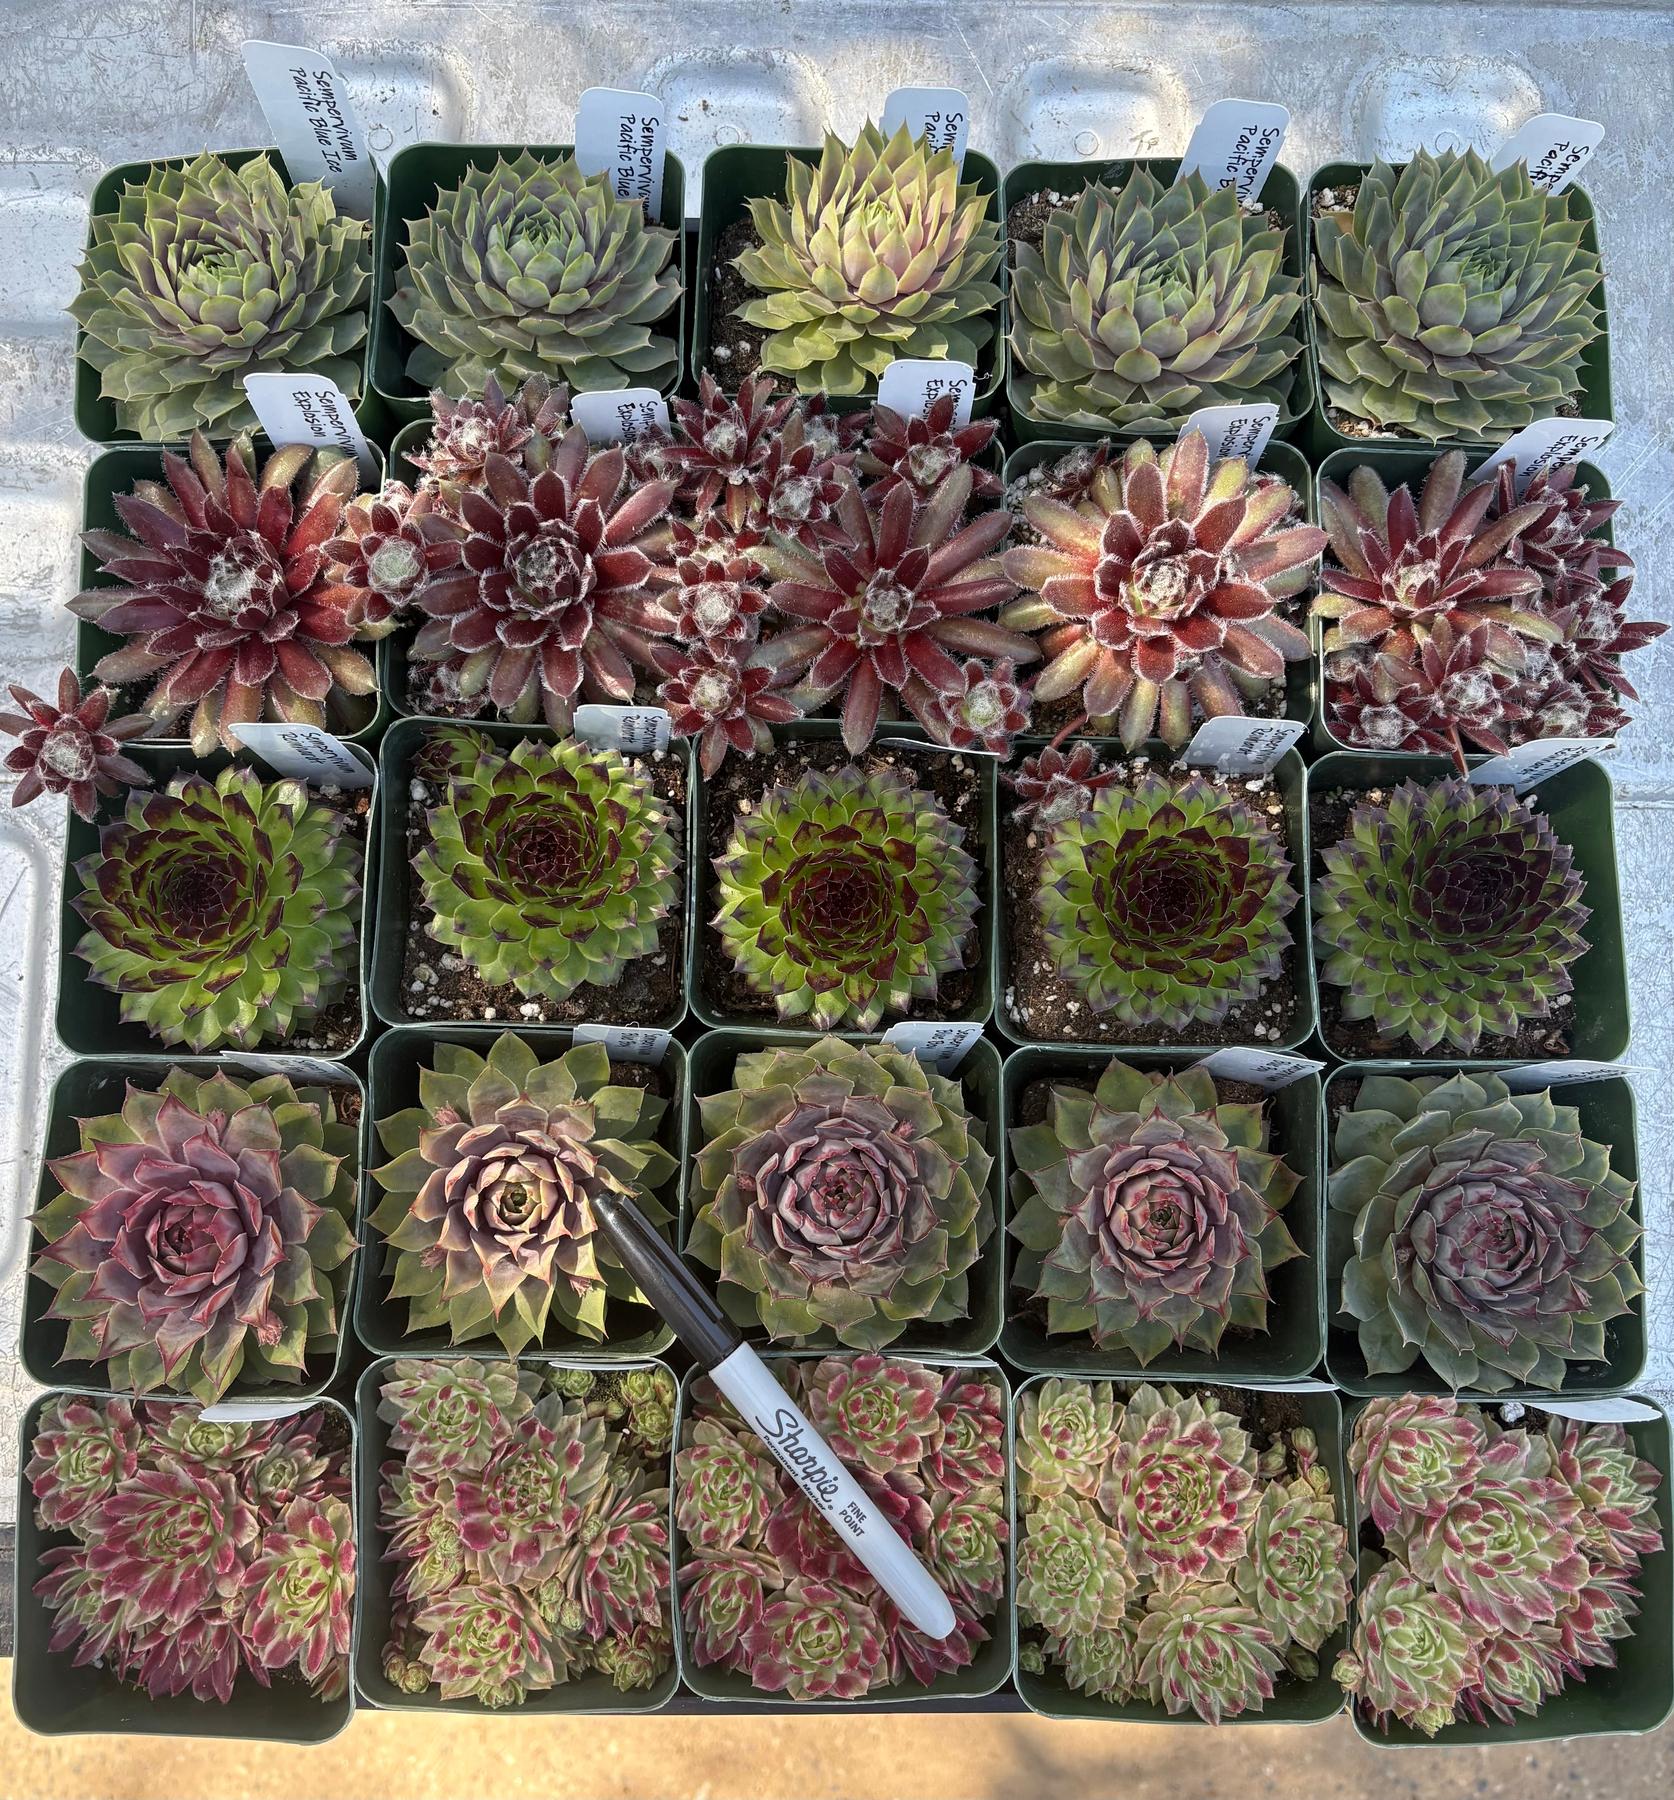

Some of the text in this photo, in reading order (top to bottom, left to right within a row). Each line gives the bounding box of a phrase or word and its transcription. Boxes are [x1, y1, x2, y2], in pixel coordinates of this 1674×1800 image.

[289, 67, 343, 173] Pacific Blue Ice
[313, 71, 358, 161] Sempervivum
[617, 114, 637, 197] Pacific Blue
[1226, 125, 1258, 173] Pacific
[292, 390, 327, 438] Explosion
[1518, 435, 1579, 477] Explosion
[755, 1408, 839, 1503] Sharpie
[763, 1434, 827, 1511] Permanent Marker
[839, 1509, 865, 1537] POINT
[847, 1501, 867, 1524] FINE
